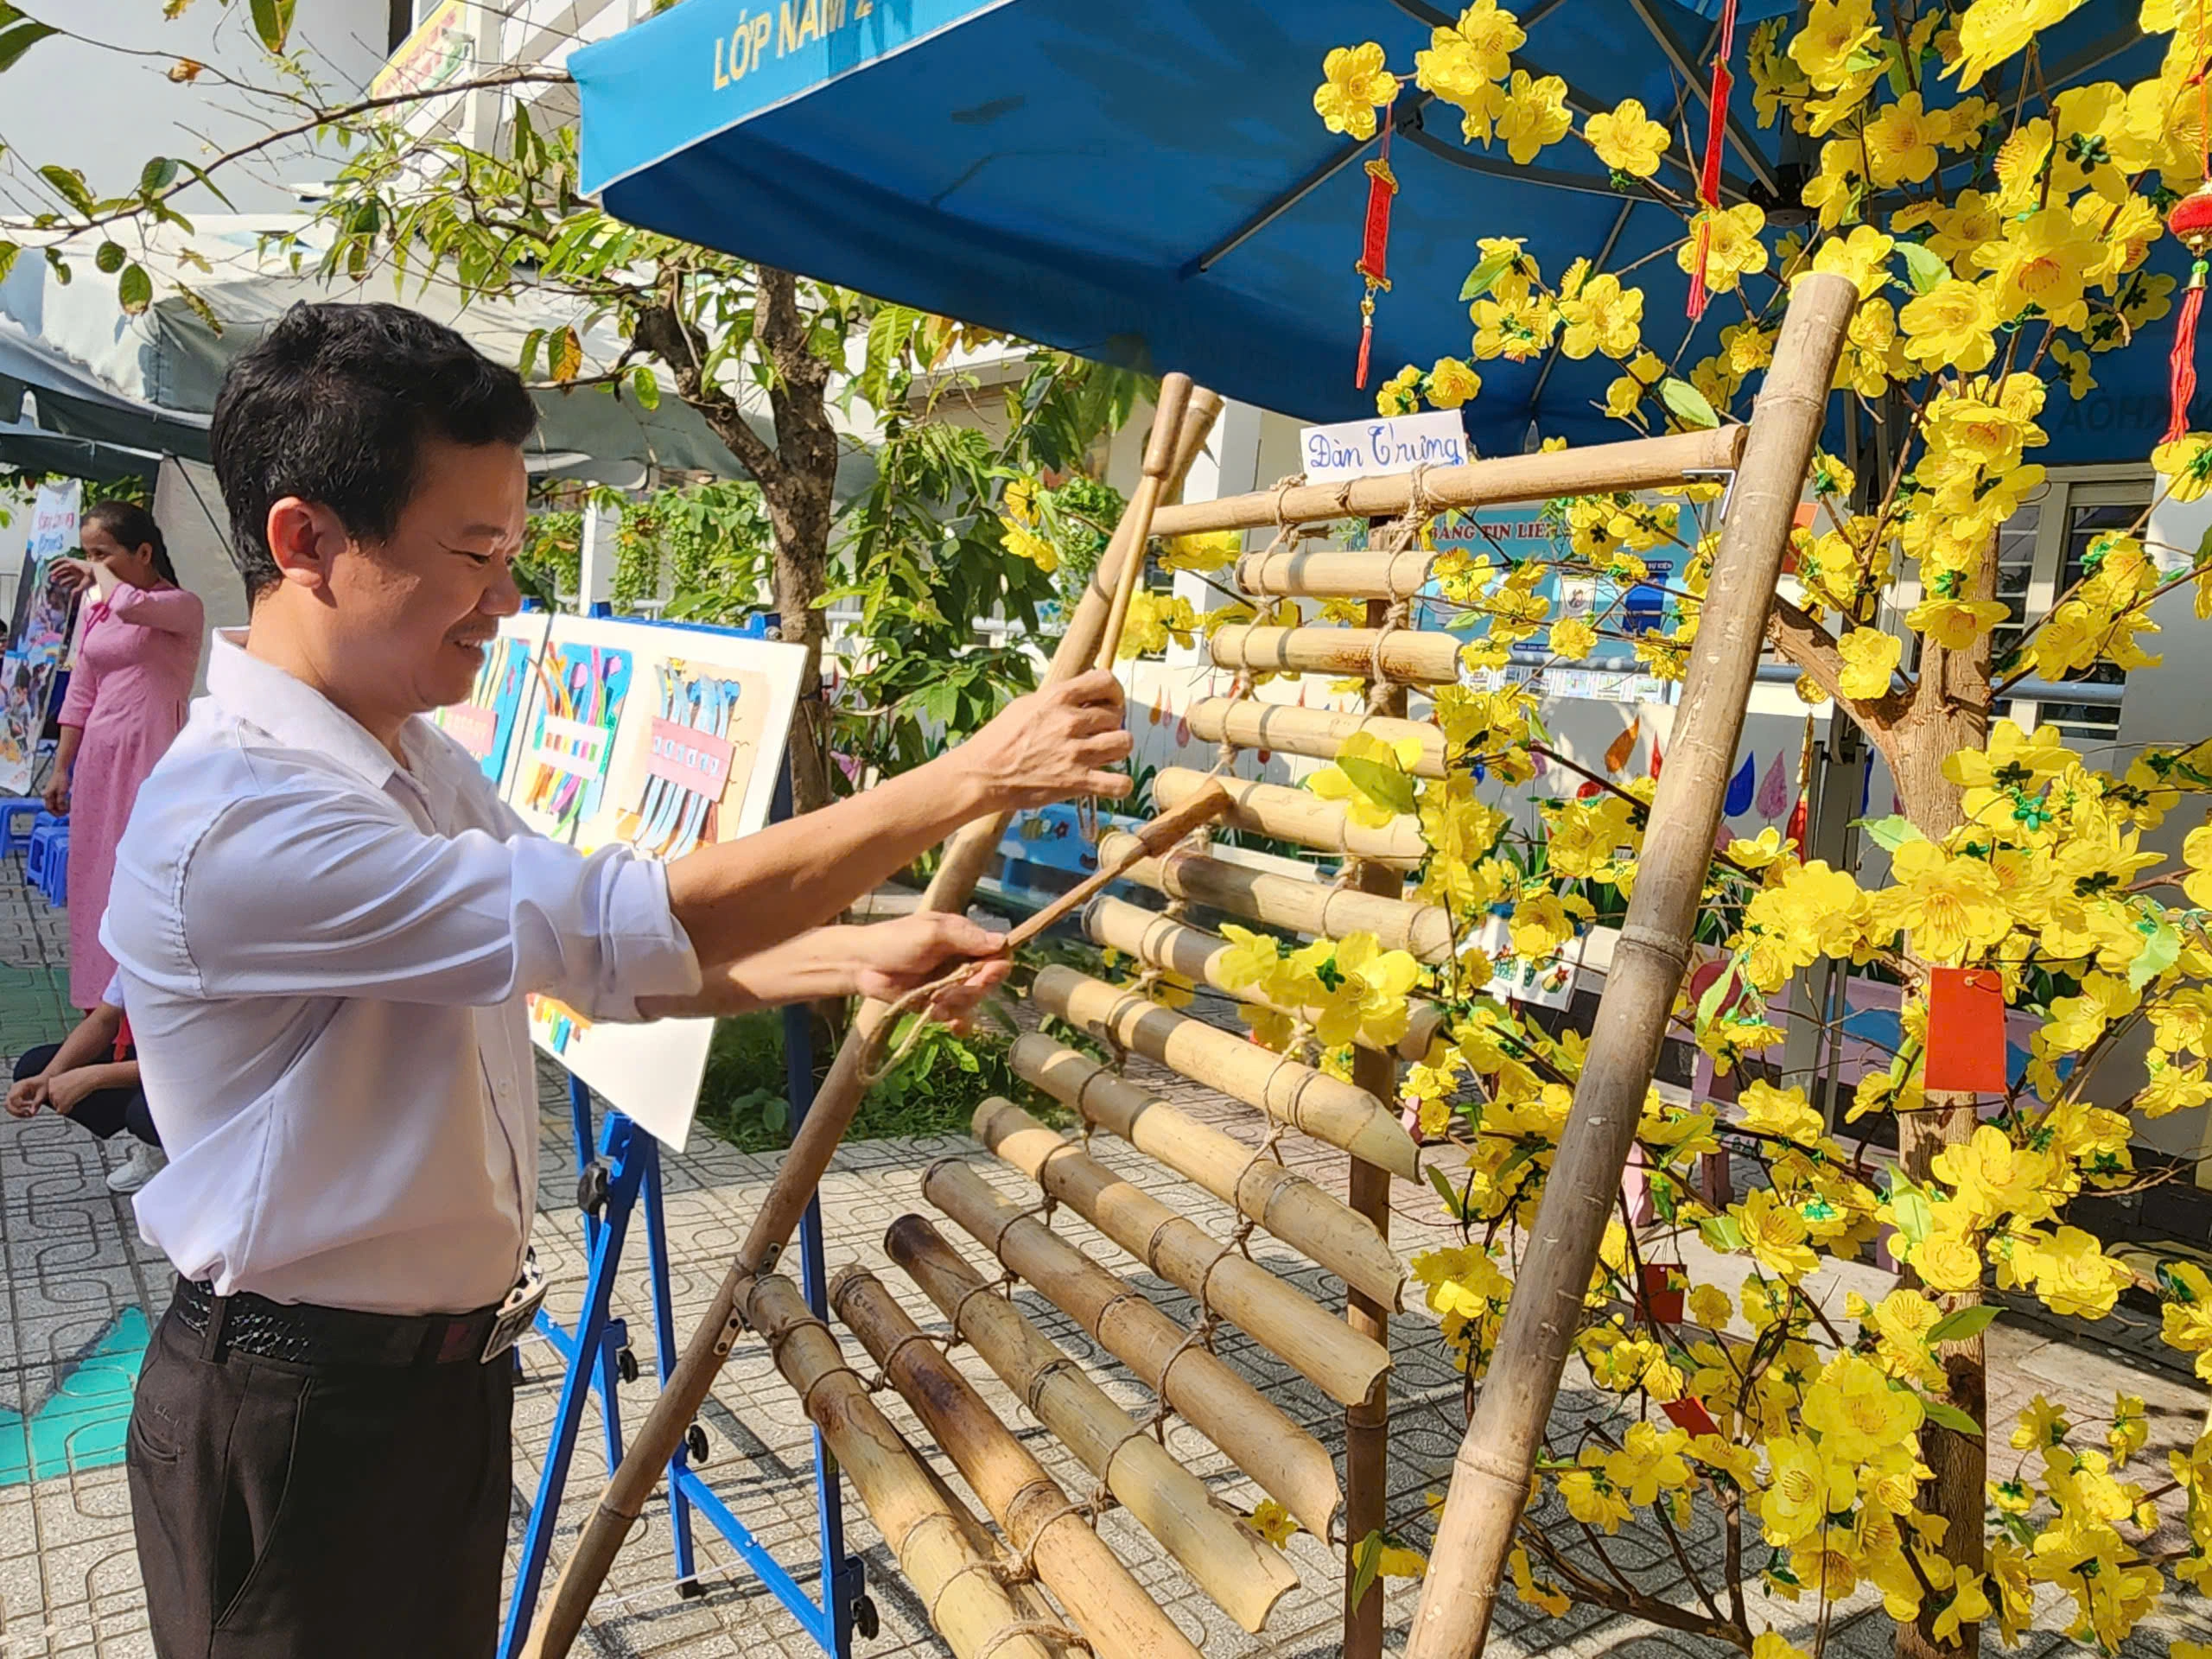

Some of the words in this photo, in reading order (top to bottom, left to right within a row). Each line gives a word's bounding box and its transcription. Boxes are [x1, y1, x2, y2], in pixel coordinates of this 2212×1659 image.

[712, 8, 772, 92] LỚP
[1308, 433, 1363, 468] Đàn
[1481, 523, 1511, 539] TIN
